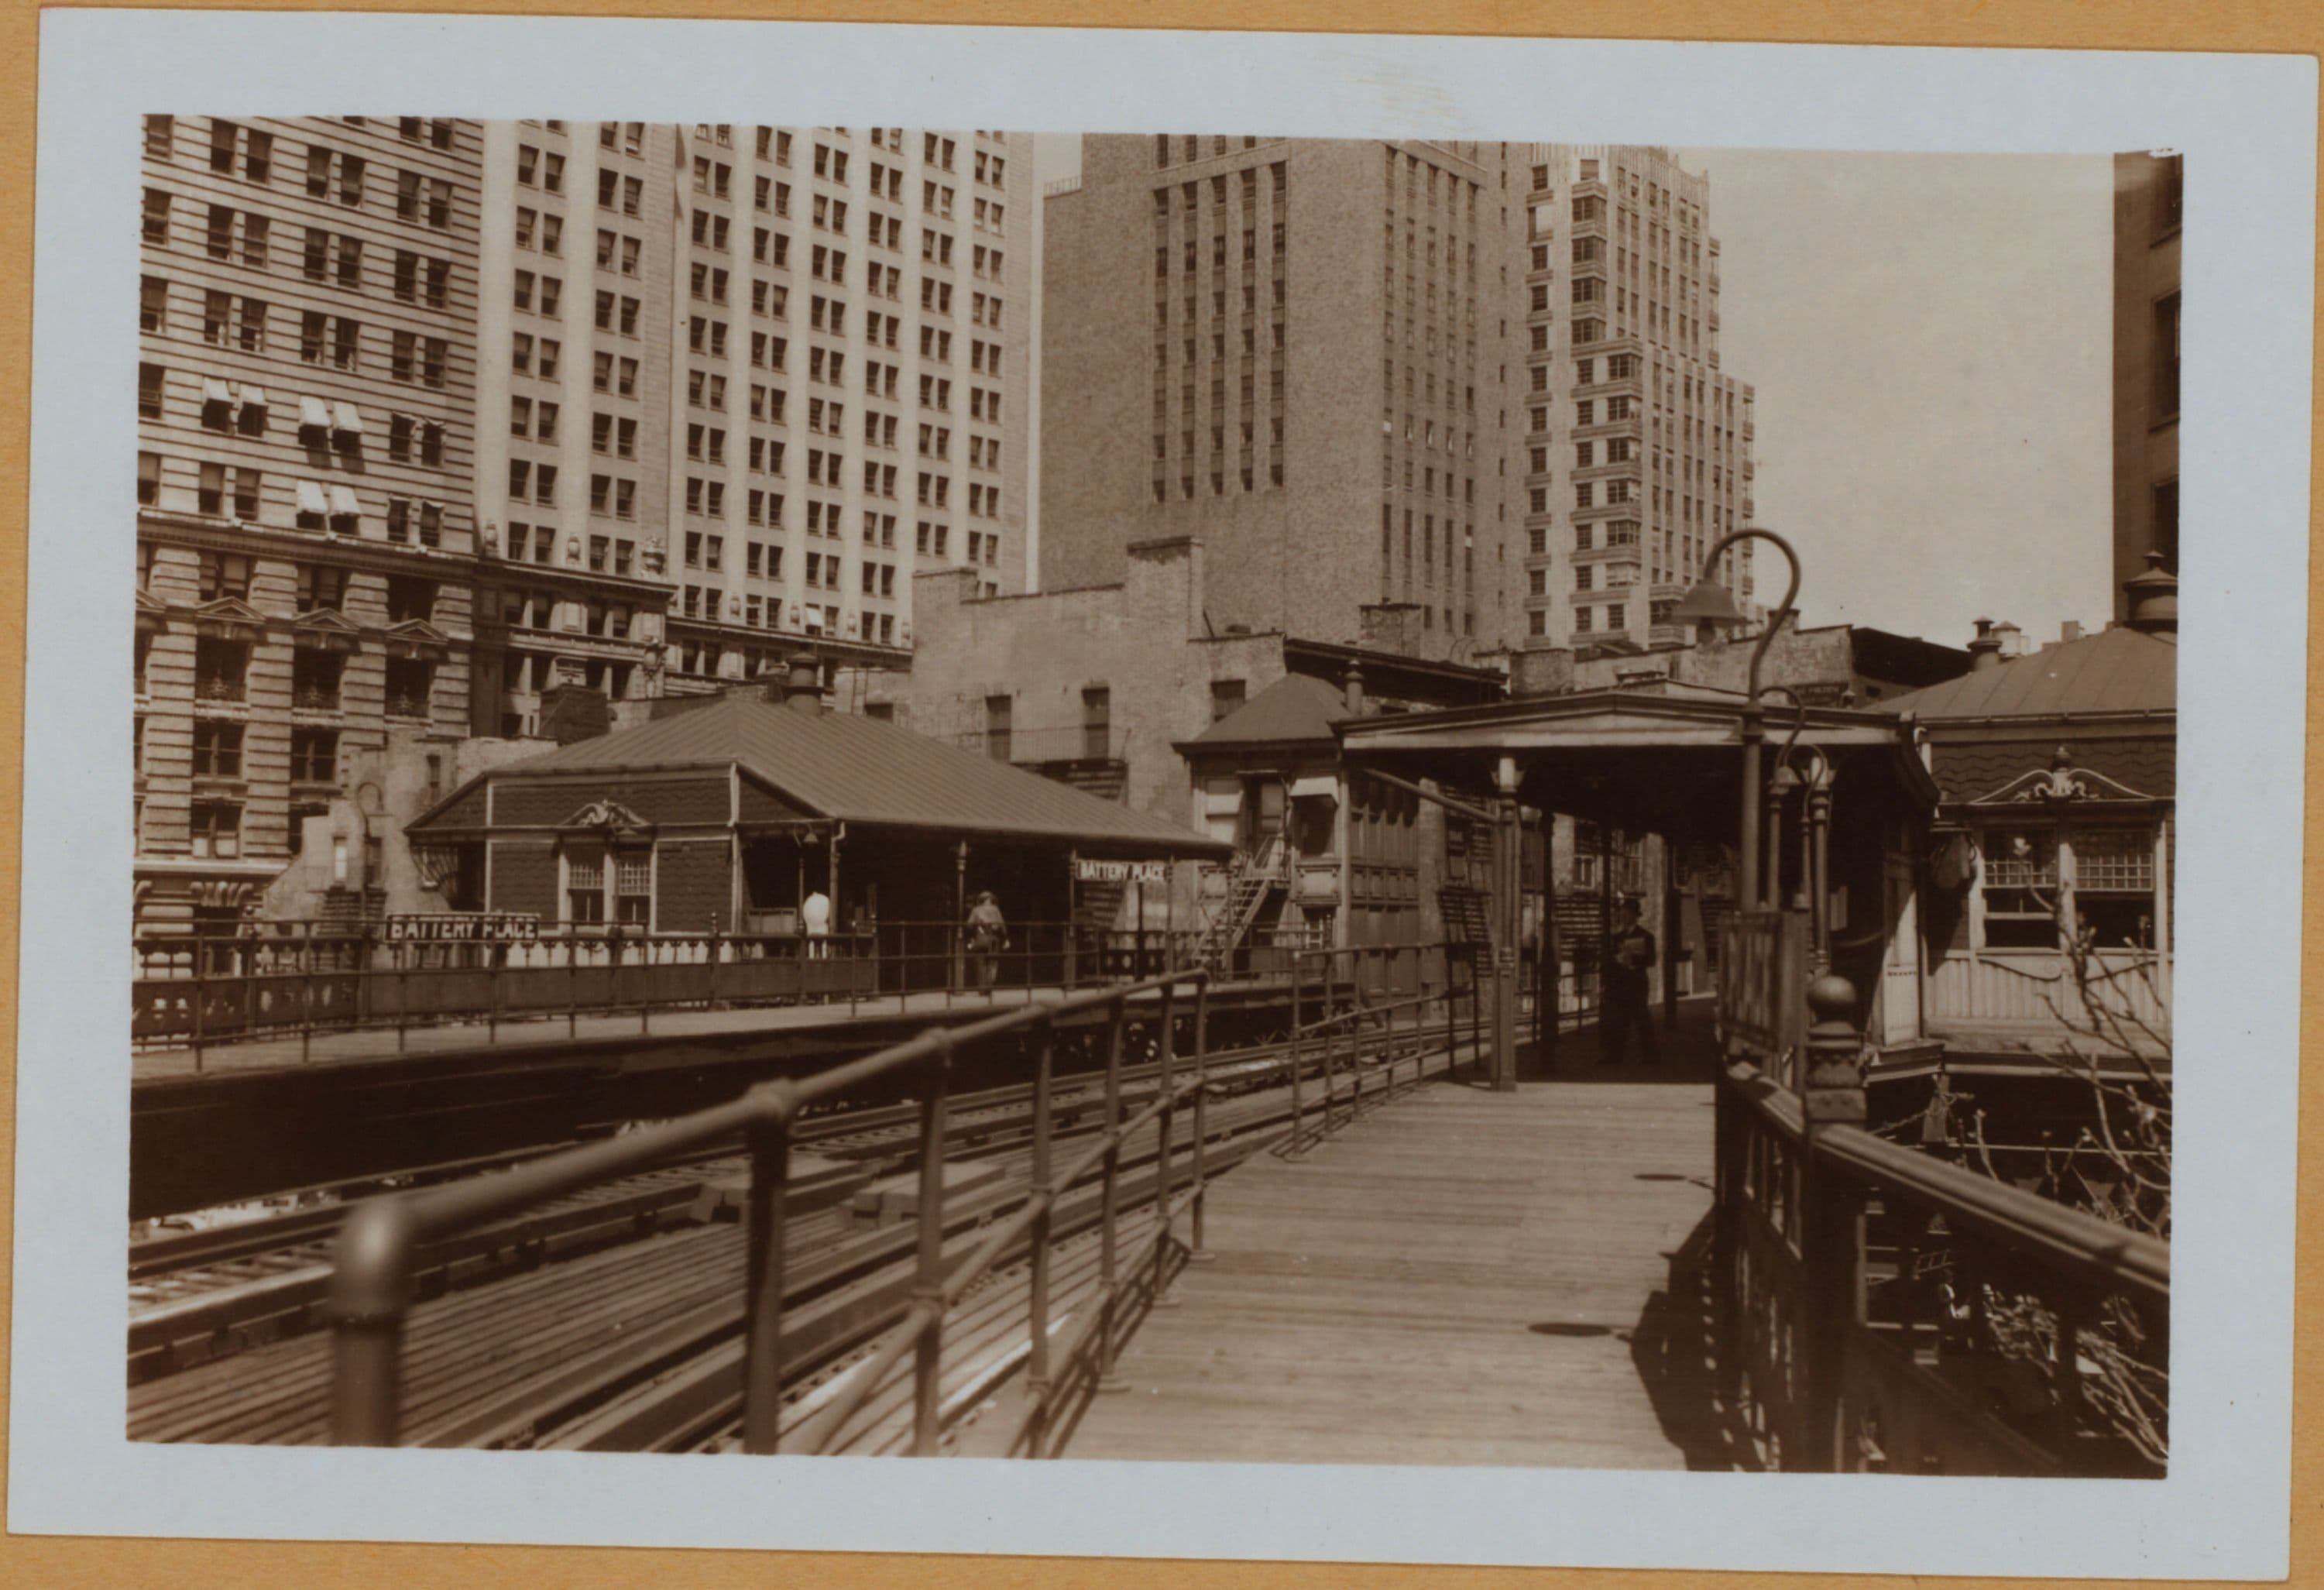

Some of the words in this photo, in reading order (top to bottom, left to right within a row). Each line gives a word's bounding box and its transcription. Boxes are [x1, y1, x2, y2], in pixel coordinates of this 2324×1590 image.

[1080, 860, 1128, 880] BATTERY
[1131, 862, 1164, 881] PLACE
[390, 916, 477, 939] BATTERY
[482, 917, 536, 939] PLACE
